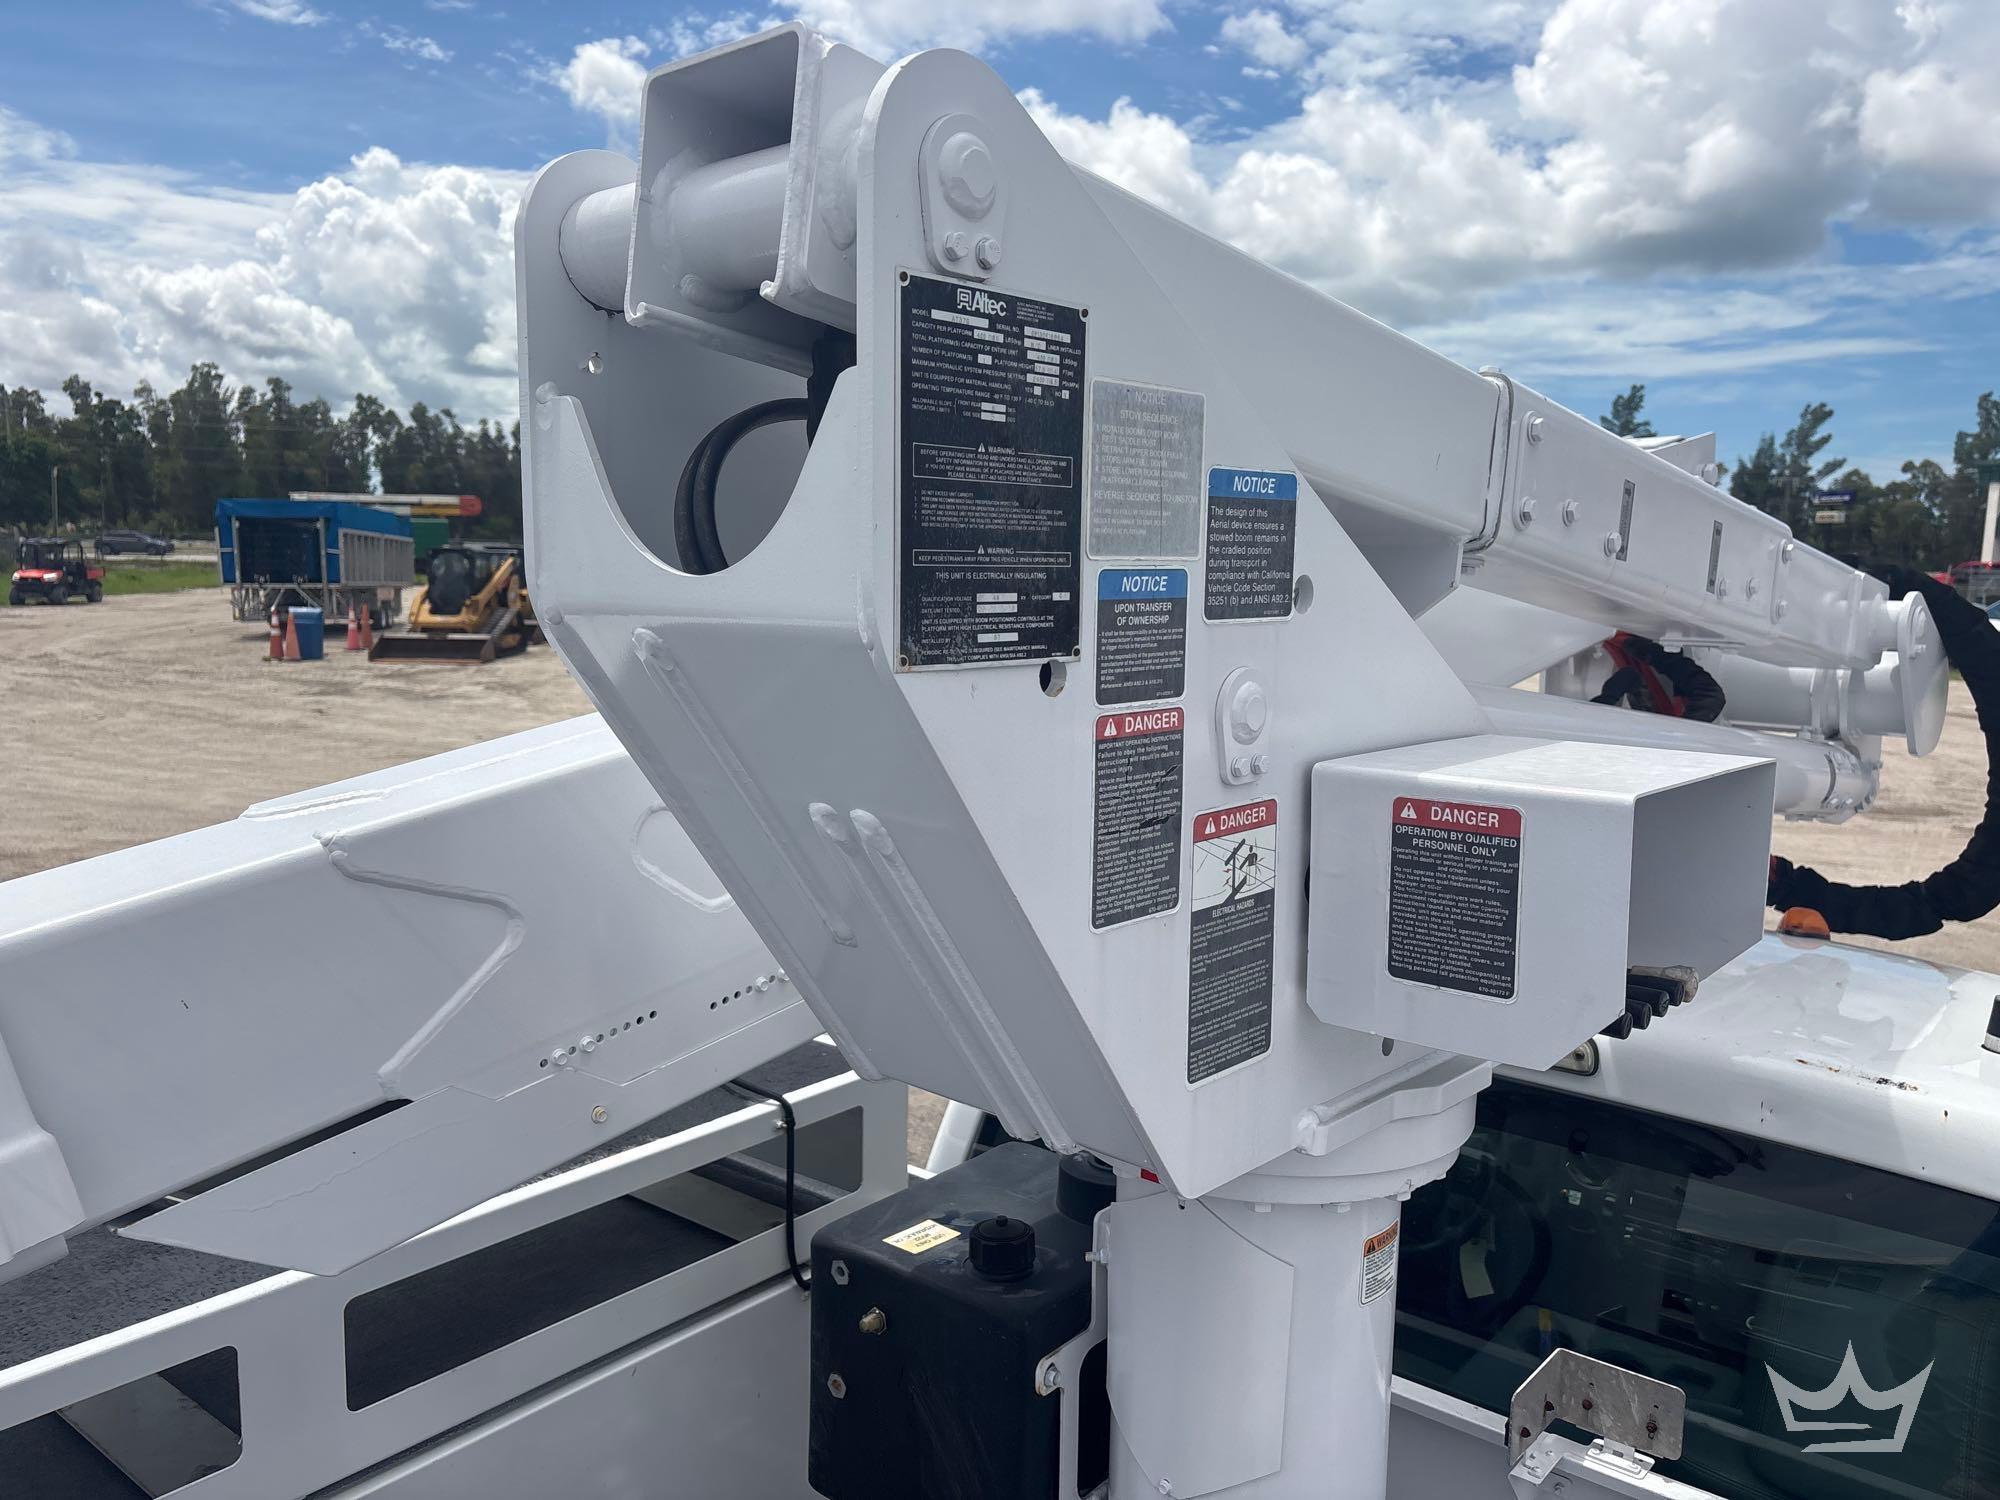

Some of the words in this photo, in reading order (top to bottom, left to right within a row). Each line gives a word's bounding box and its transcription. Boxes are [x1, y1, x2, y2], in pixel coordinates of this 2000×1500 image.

[972, 291, 1006, 316] Altec
[912, 308, 930, 317] MODEL
[912, 321, 935, 329] CAPACITY
[947, 327, 972, 336] PLATFORM
[912, 333, 927, 341] TOTAL
[961, 341, 983, 350] CAPACITY
[936, 361, 963, 371] HYDRAULIC
[964, 365, 982, 373] SYSTEM
[1233, 475, 1276, 494] NOTICE
[1094, 490, 1125, 500] REVERSE
[1210, 505, 1224, 516] The
[1226, 508, 1247, 519] design
[1248, 507, 1255, 517] of
[1256, 508, 1268, 518] this
[1210, 519, 1230, 529] Aerial
[1231, 520, 1252, 530] device
[1254, 522, 1279, 531] ensures
[1210, 532, 1234, 542] stowed
[1235, 533, 1253, 542] boom
[1254, 535, 1279, 543] remains
[1281, 534, 1287, 542] in
[987, 547, 1014, 555] WARNING
[1210, 545, 1220, 555] the
[1221, 545, 1246, 555] cradled
[1247, 546, 1272, 556] position
[1208, 558, 1230, 569] during
[1231, 559, 1260, 569] transport
[1261, 559, 1268, 567] in
[936, 572, 949, 580] THIS
[950, 572, 965, 580] UNIT
[966, 572, 972, 580] IS
[973, 572, 1013, 580] ELECTRICALLY
[1014, 572, 1047, 580] INSULATING
[1208, 571, 1245, 581] compliance
[1247, 571, 1260, 579] with
[1261, 570, 1290, 579] California
[1121, 576, 1168, 592] NOTICE
[1208, 583, 1232, 593] Vehicle
[1234, 582, 1251, 592] Code
[1252, 582, 1276, 592] Section
[1207, 596, 1227, 606] 35251
[1230, 595, 1239, 606] (b)
[1240, 595, 1253, 604] and
[1254, 594, 1270, 604] ANSI
[1114, 603, 1135, 613] UPON
[1136, 602, 1172, 612] TRANSFER
[1116, 616, 1127, 626] OF
[1128, 615, 1170, 626] OWNERSHIP
[1125, 712, 1178, 733] DANGER
[1099, 741, 1124, 750] IMPORTANT
[1125, 737, 1150, 746] OPERATING
[1151, 733, 1181, 743] INSTRUCTIONS
[1098, 751, 1116, 759] Failure
[1124, 749, 1135, 757] obey
[1146, 744, 1168, 752] following
[1098, 767, 1117, 776] serious
[1220, 807, 1266, 830] DANGER
[1431, 806, 1499, 828] DANGER
[1395, 825, 1448, 839] OPERATION
[1450, 831, 1463, 841] BY
[1465, 834, 1517, 848] QUALIFIED
[1412, 838, 1469, 853] PERSONNEL
[1471, 846, 1497, 857] ONLY
[1393, 846, 1418, 855] Operating
[1431, 850, 1441, 858] unit
[1443, 852, 1463, 860] without
[1465, 856, 1483, 864] proper
[1485, 858, 1506, 868] training
[1508, 860, 1518, 868] will
[1420, 856, 1434, 864] death
[1443, 860, 1463, 868] serious
[1465, 862, 1480, 871] injury
[1490, 866, 1513, 874] yourself
[1394, 879, 1418, 887] employer
[1413, 869, 1434, 877] operate
[1448, 873, 1478, 883] equipment
[1212, 904, 1236, 918] ELECTRICAL
[1236, 898, 1254, 911] HAZARDS
[1414, 966, 1438, 975] personal
[1450, 972, 1479, 983] protection
